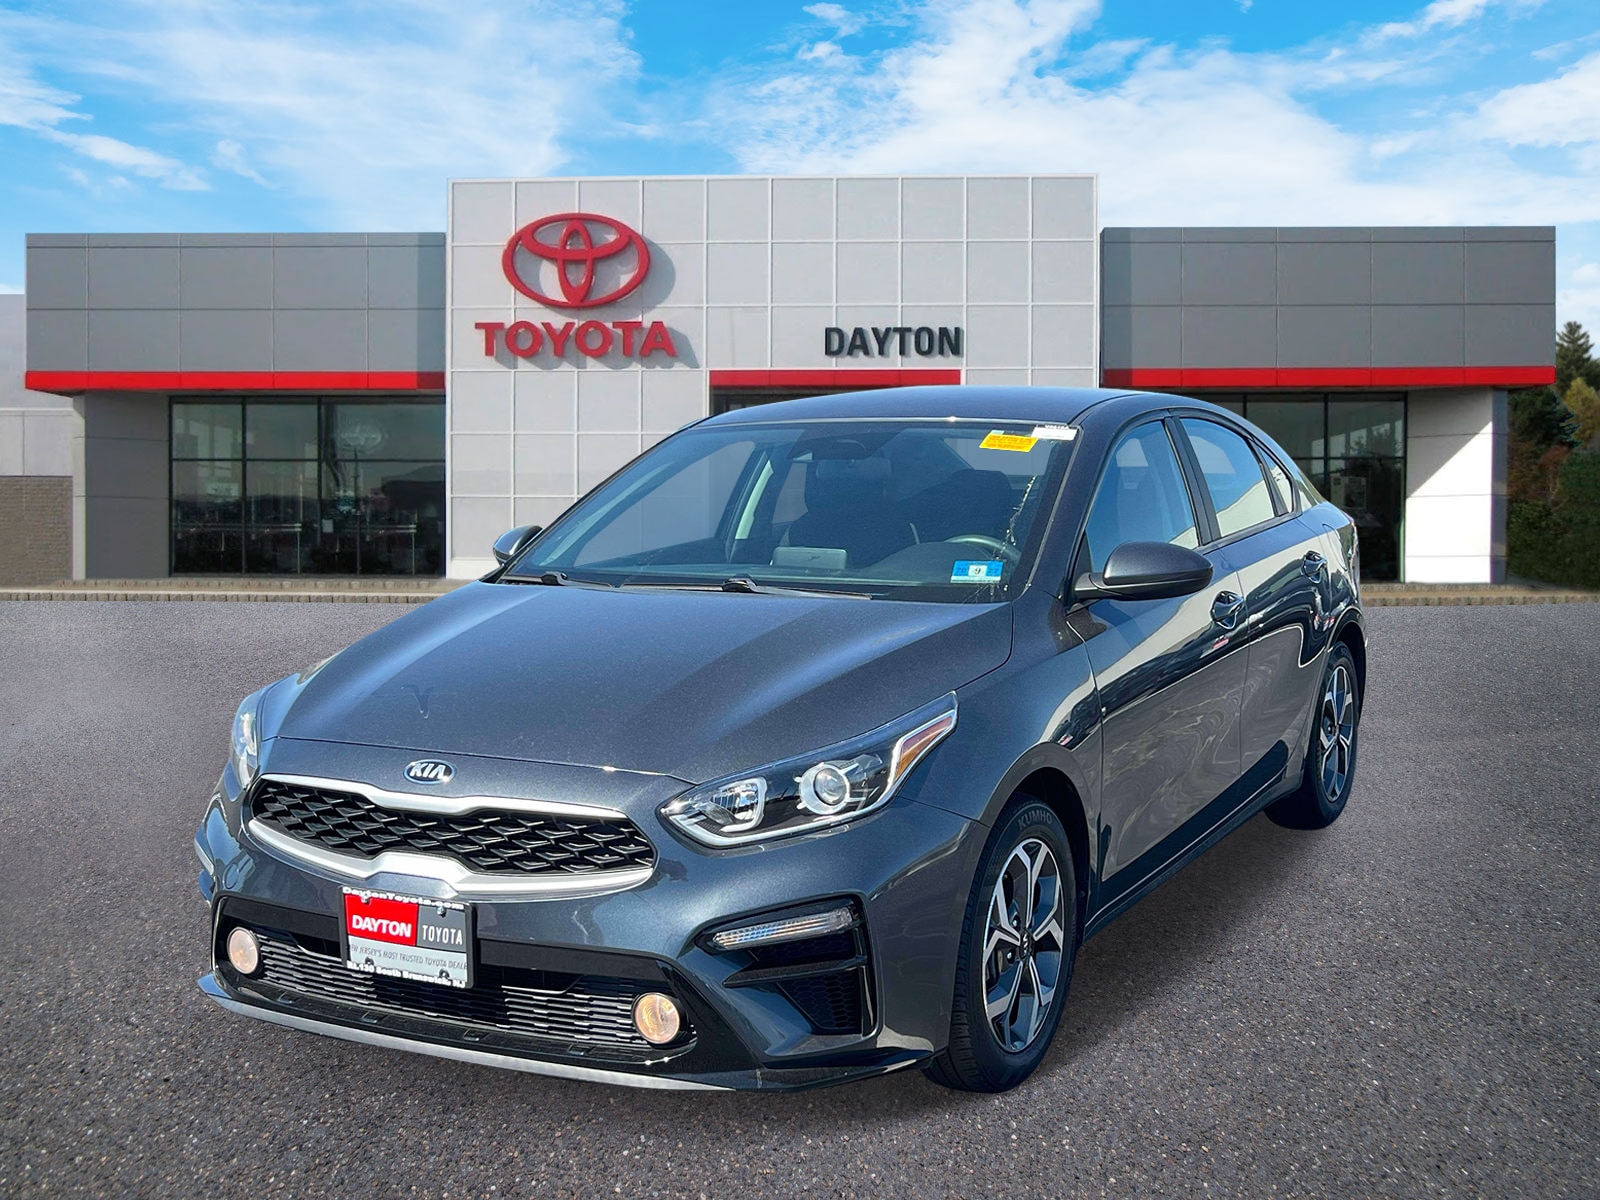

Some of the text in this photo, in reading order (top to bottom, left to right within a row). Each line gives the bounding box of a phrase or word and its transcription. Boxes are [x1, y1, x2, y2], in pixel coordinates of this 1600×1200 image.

[475, 321, 677, 358] TOYOTA
[824, 327, 964, 357] DAYTON
[409, 762, 446, 780] KIA
[1018, 810, 1053, 829] KUMHO
[342, 886, 465, 910] DaytonToyota.com
[352, 914, 412, 938] DAYTON
[422, 925, 463, 945] TOYOTA
[359, 945, 382, 958] JERSEY'S
[383, 950, 398, 960] MOST
[400, 952, 424, 965] TRUSTED
[425, 957, 447, 968] TOYOTA
[376, 966, 401, 977] South
[453, 979, 466, 989] NJ
